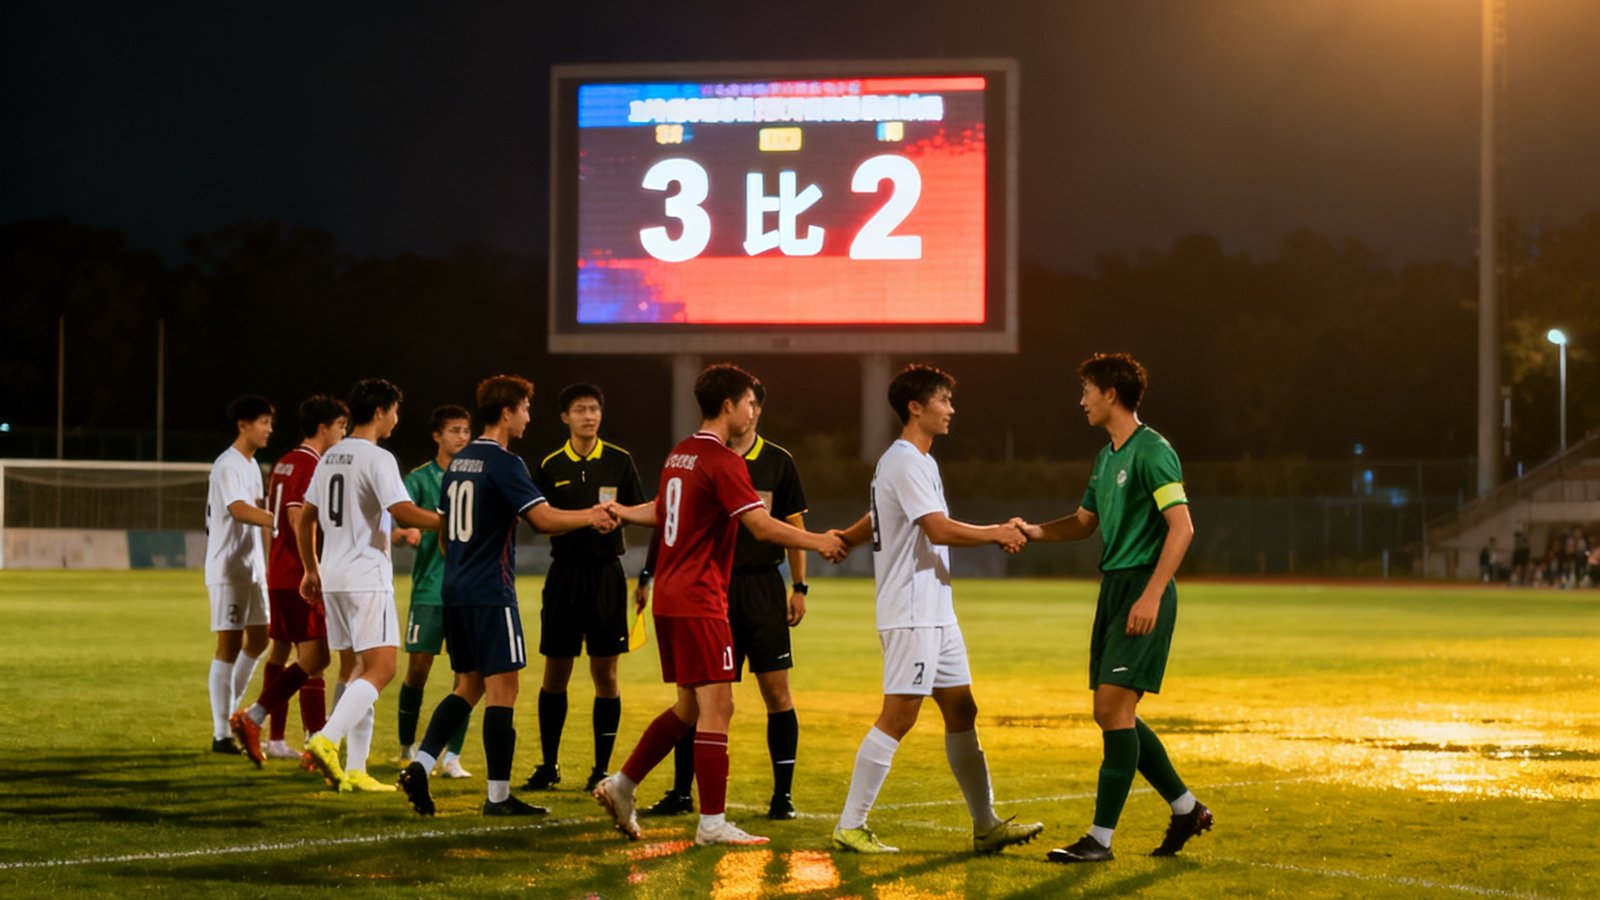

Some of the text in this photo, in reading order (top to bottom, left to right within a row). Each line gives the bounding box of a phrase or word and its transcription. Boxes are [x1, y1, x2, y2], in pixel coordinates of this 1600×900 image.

[640, 154, 922, 262] 3 比 2
[447, 480, 475, 543] 10
